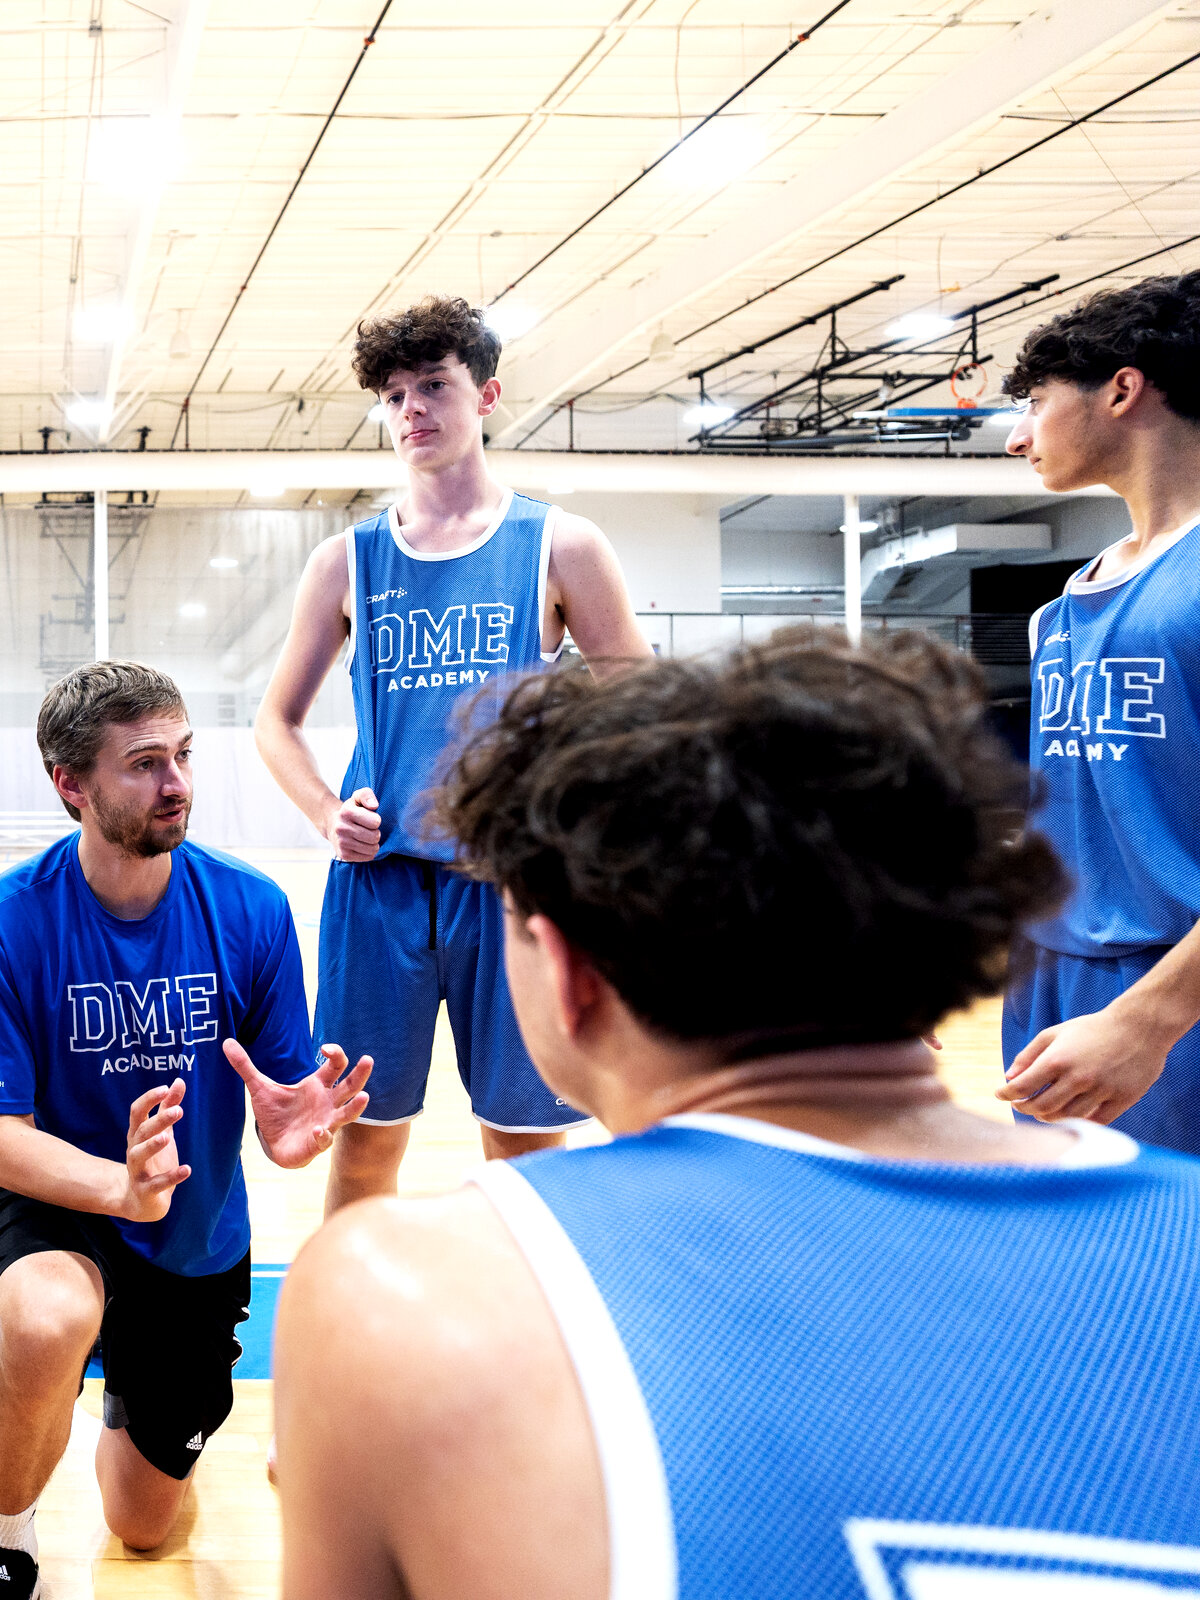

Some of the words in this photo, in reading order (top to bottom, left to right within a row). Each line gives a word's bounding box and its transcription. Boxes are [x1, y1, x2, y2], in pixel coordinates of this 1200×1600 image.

[366, 589, 398, 604] CRAFT
[369, 602, 515, 677] DME
[387, 669, 490, 693] ACADEMY
[67, 973, 219, 1052] DME
[101, 1053, 196, 1076] ACADEMY
[185, 1442, 204, 1451] adidas
